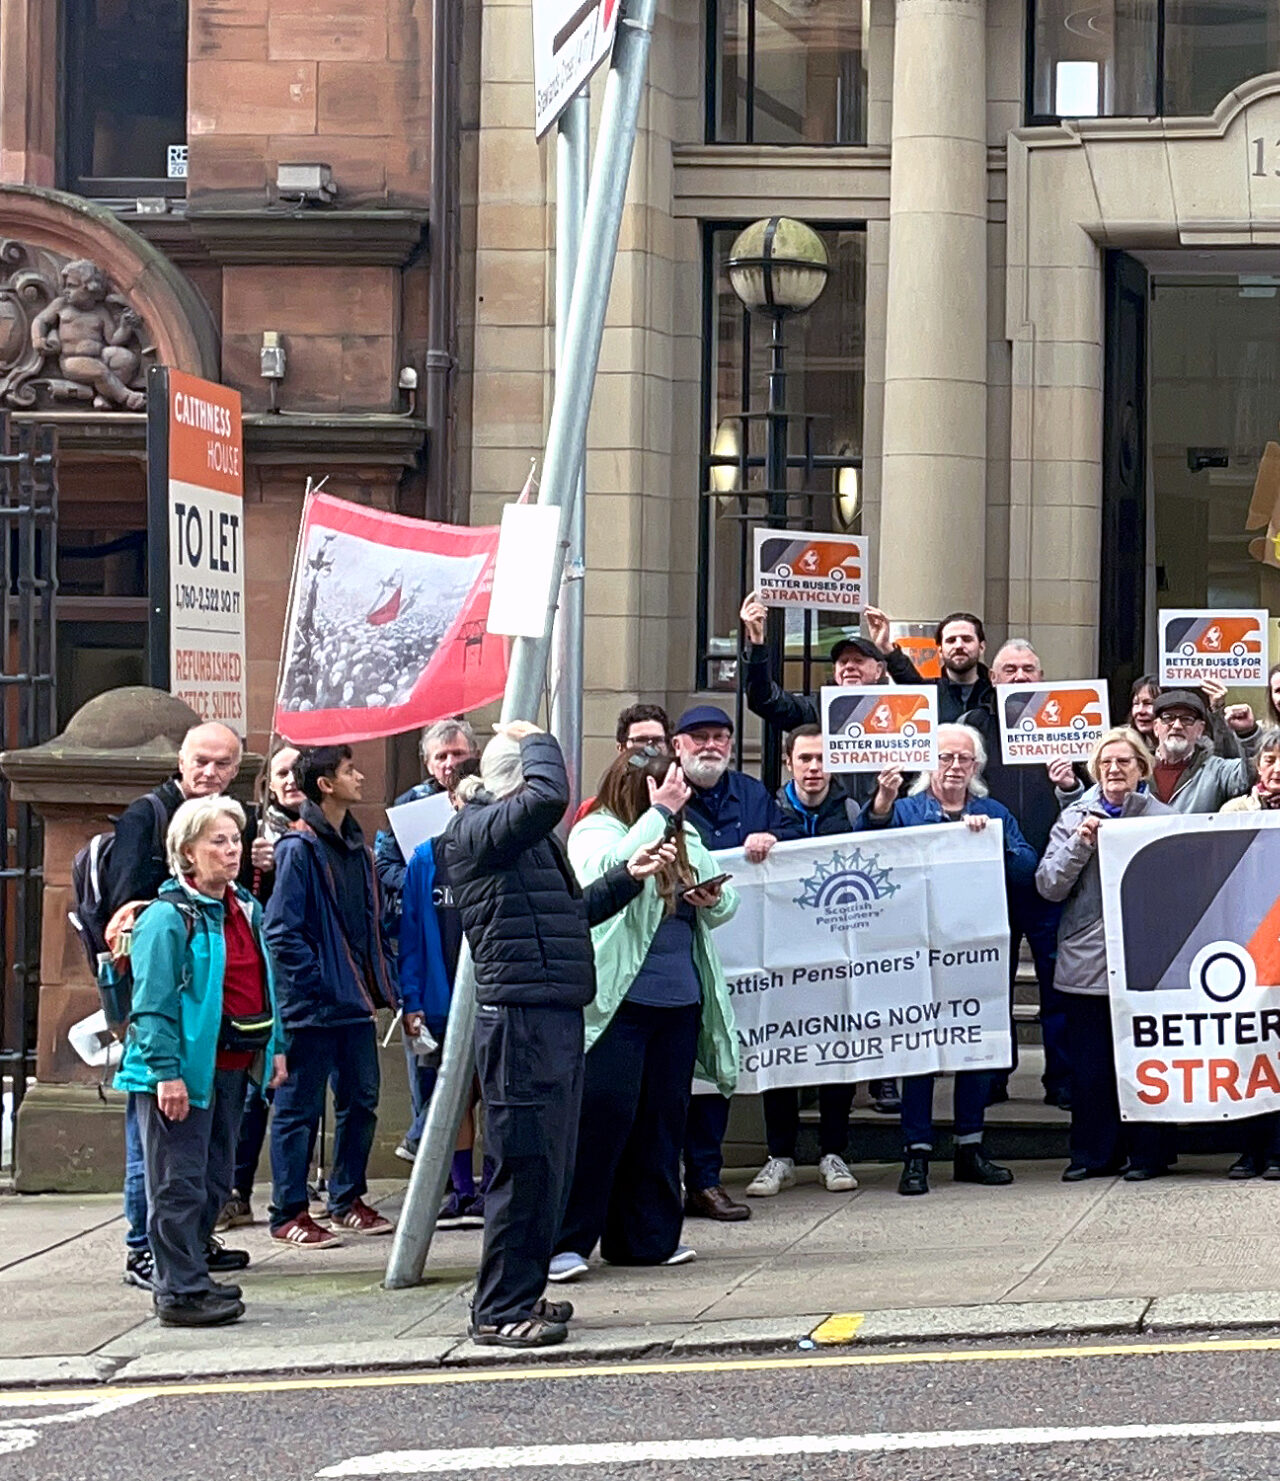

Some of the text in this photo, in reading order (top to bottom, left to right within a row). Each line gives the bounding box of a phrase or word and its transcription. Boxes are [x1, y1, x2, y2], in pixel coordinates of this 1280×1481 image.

[174, 391, 231, 438] CAITHNESS
[207, 441, 239, 476] HOUSE
[175, 503, 239, 574] TO LET
[760, 578, 861, 593] BETTER BUSES FOR
[221, 588, 231, 613] SQ
[232, 591, 240, 613] FT
[760, 588, 861, 605] STRATHCLYDE
[176, 649, 242, 682] REFURBISHED
[1165, 657, 1261, 666] BETTER BUSES FOR
[1166, 668, 1261, 679] STRATHCLYDE
[177, 690, 243, 719] FFICE SUITES
[829, 739, 931, 750] BETTER BUSES FOR
[1007, 731, 1103, 743] BETTER BUSES FOR
[1008, 742, 1094, 756] STRATHCLYD
[829, 751, 931, 765] STRATHCLYDE
[825, 902, 873, 915] Scottish
[830, 921, 870, 933] Forum
[726, 971, 784, 996] ottish
[928, 947, 1000, 968] Forum
[737, 998, 981, 1048] AMPAIGNING NOW TO
[815, 1037, 884, 1062] YOUR
[890, 1025, 982, 1053] FUTURE
